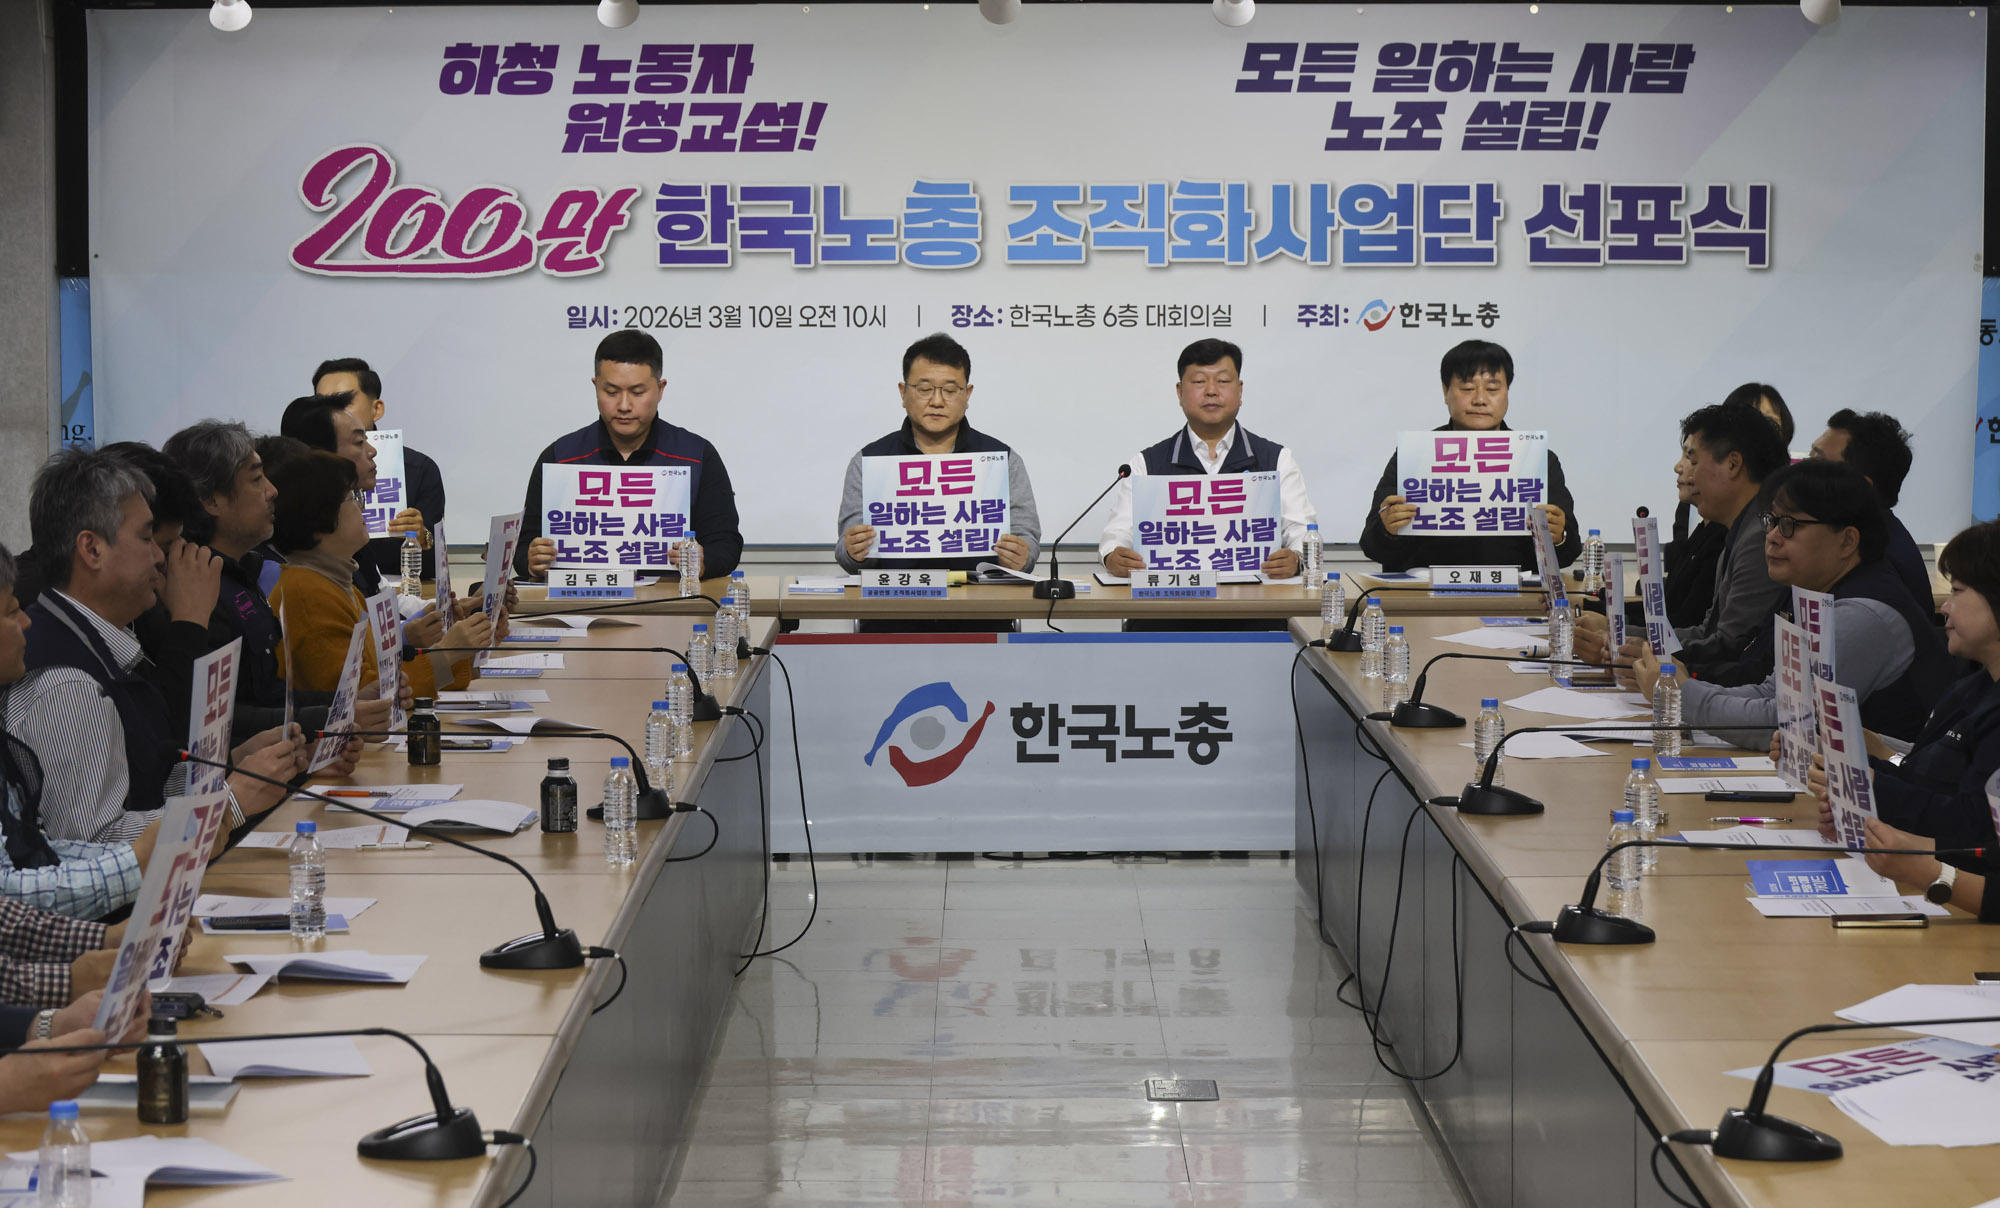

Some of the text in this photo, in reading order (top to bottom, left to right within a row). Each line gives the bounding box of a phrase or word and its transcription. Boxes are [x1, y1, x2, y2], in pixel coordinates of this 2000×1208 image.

[439, 43, 754, 95] 하청 노동자
[1235, 40, 1696, 93] 모든 일하는 사람
[562, 101, 828, 153] 원청교섭!
[1325, 101, 1611, 151] 노조 설립!
[290, 145, 1771, 275] 200만 한국노총 조직화사업단 선포식
[567, 305, 885, 330] 일시: 2026년 3월 10일 오전 10시
[952, 304, 1231, 327] 장소: 한국노총 6층 대회의실
[1298, 302, 1500, 328] 주최: 한국노총
[1432, 438, 1513, 473] 모든
[576, 472, 656, 507] 모든
[896, 460, 975, 496] 모든
[1403, 478, 1543, 505] 일하는 사람
[868, 499, 1006, 526] 일하는 사람
[1166, 479, 1246, 516] 모든
[548, 510, 686, 537] 일하는 사람
[1139, 516, 1277, 545] 일하는 사람
[1412, 507, 1525, 531] 노조 설립
[557, 540, 668, 565] 노조 설립
[878, 530, 930, 552] 노조
[1148, 549, 1201, 570] 노조
[376, 599, 396, 652] 모든
[1782, 628, 1802, 692] 모든
[204, 653, 232, 726] 모든
[1010, 702, 1233, 765] 한국노총
[1820, 689, 1845, 753] 든
[1840, 762, 1871, 812] 사람
[1788, 1047, 1941, 1078] 모든
